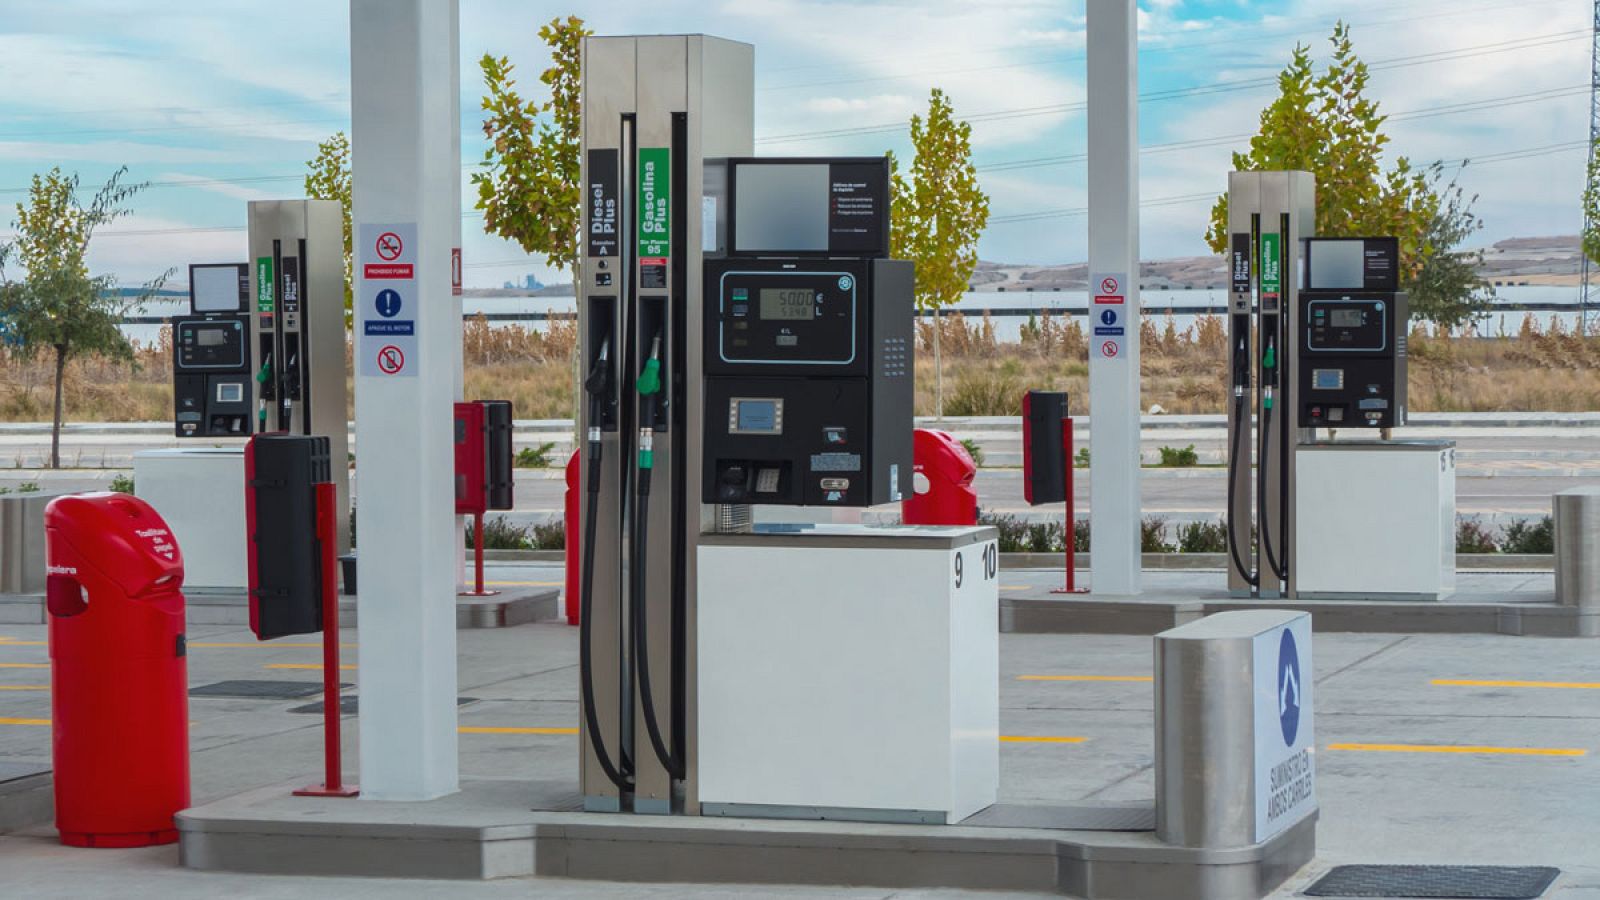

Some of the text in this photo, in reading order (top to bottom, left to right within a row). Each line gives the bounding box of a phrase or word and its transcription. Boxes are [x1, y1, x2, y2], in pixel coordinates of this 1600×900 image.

[592, 183, 603, 234] Diesel
[643, 161, 654, 233] Gasolina
[655, 198, 666, 233] Plus
[604, 199, 615, 234] Plus
[647, 245, 661, 254] 95
[1234, 252, 1242, 280] Diesel
[1263, 240, 1271, 280] Gasolina
[955, 542, 996, 588] 9 10
